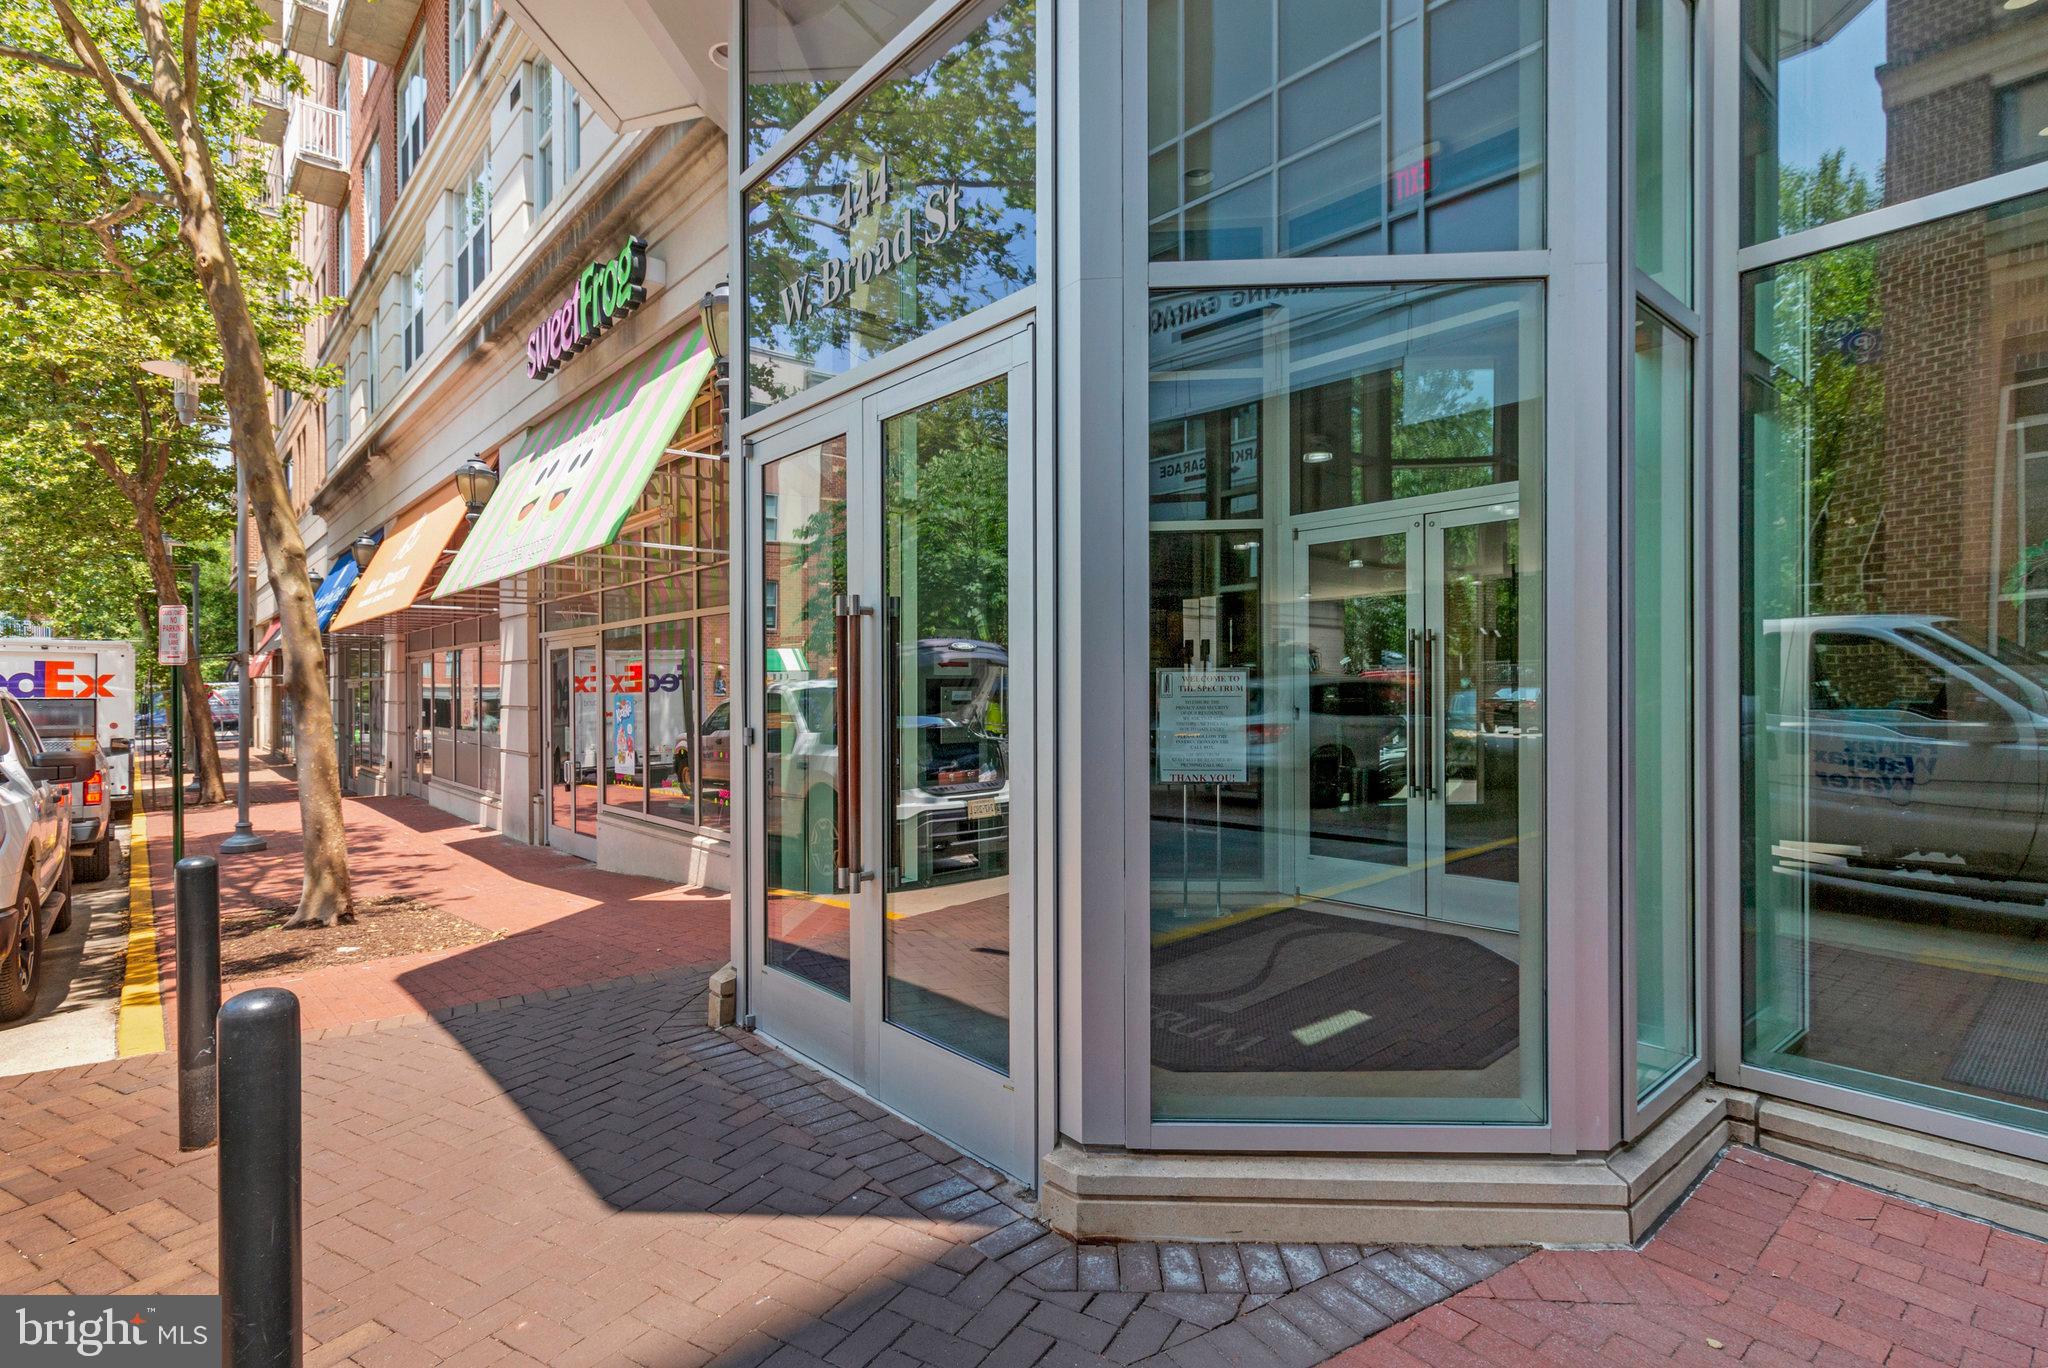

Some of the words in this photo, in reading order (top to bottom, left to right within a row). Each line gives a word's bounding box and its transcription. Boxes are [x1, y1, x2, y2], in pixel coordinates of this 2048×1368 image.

[837, 154, 889, 231] 444
[779, 272, 813, 327] W.
[820, 208, 913, 309] Broad
[923, 182, 965, 247] St
[162, 624, 185, 632] PARKING
[169, 616, 178, 624] NO
[0, 660, 116, 698] dEx
[1169, 774, 1206, 782] THANK
[1208, 774, 1236, 782] YOU!
